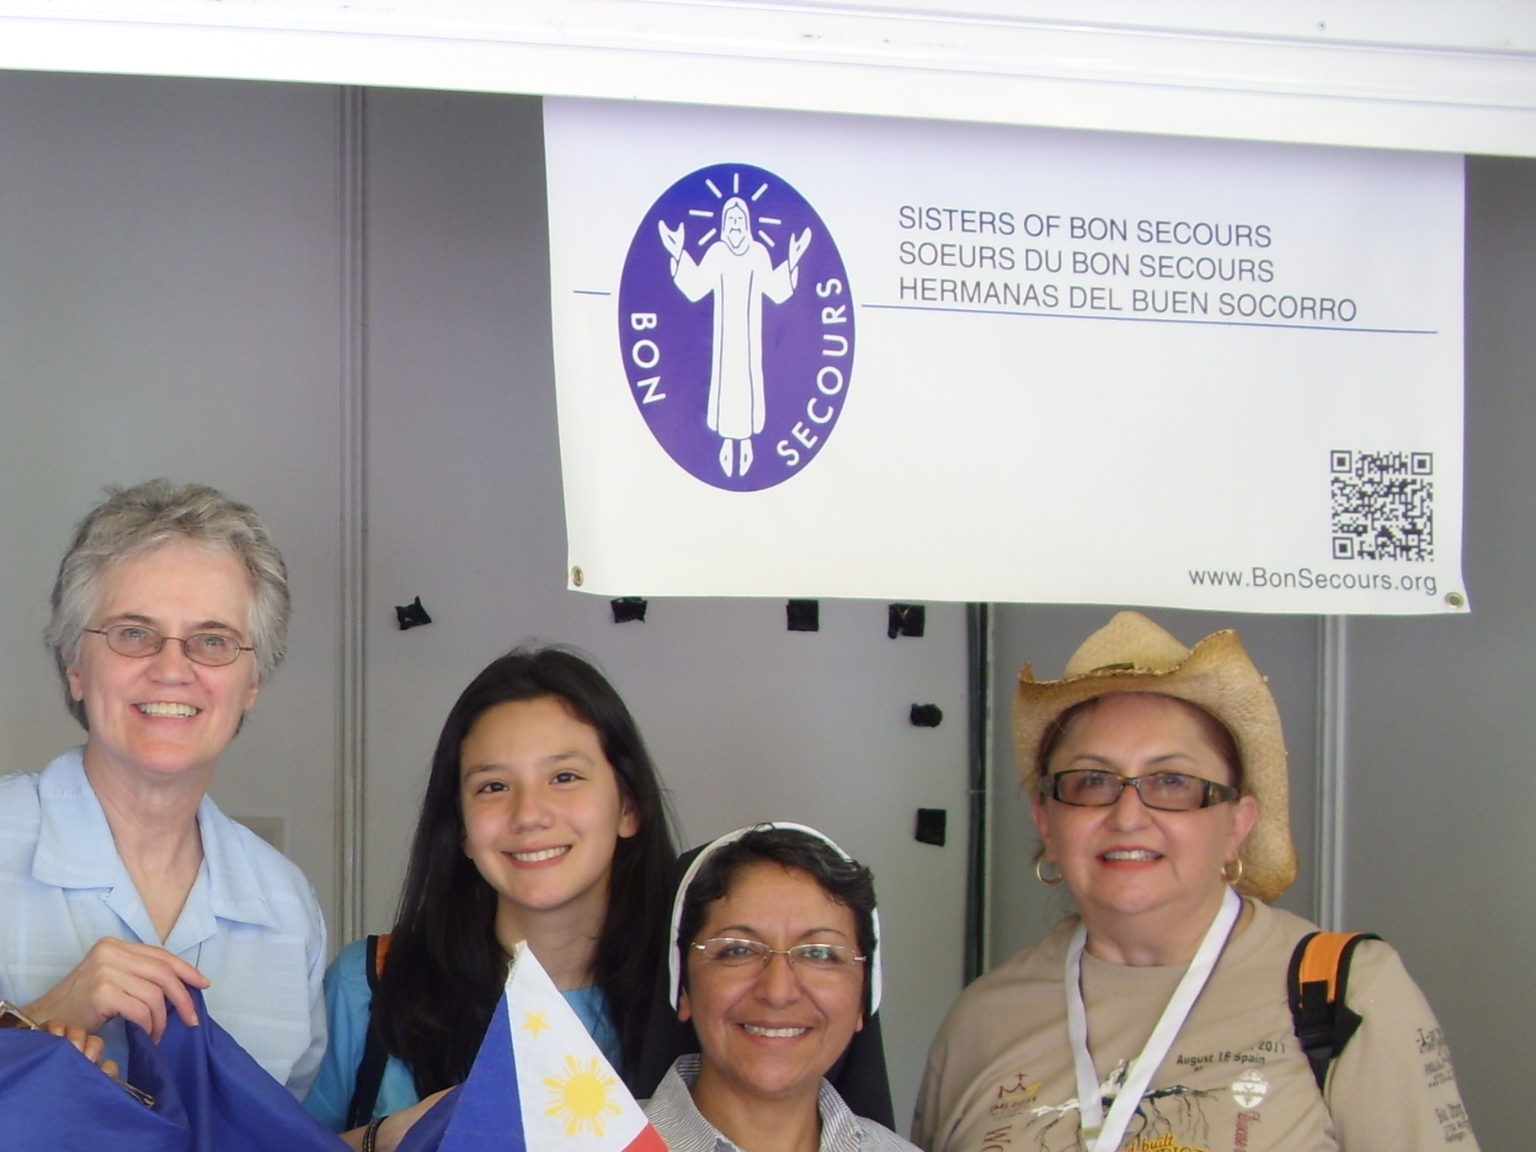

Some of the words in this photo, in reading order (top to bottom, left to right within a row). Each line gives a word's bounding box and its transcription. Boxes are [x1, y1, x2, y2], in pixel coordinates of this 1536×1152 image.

[899, 205, 1015, 235] SISTERS
[1023, 214, 1061, 238] OF
[1069, 217, 1128, 242] BON
[1136, 220, 1272, 248] SECOURS
[899, 241, 1015, 270] SOEURS
[1024, 249, 1063, 274] DU
[1072, 251, 1130, 277] BON
[1139, 254, 1275, 283] SECOURS
[899, 277, 1060, 308] HERMANAS
[1069, 286, 1123, 311] DEL
[1132, 289, 1209, 315] BUEN
[1218, 293, 1358, 323] SOCORRO
[630, 312, 667, 404] BON
[776, 277, 849, 466] SECOURS
[1188, 566, 1438, 596] www.BonSecours.org
[1141, 1133, 1175, 1151] built
